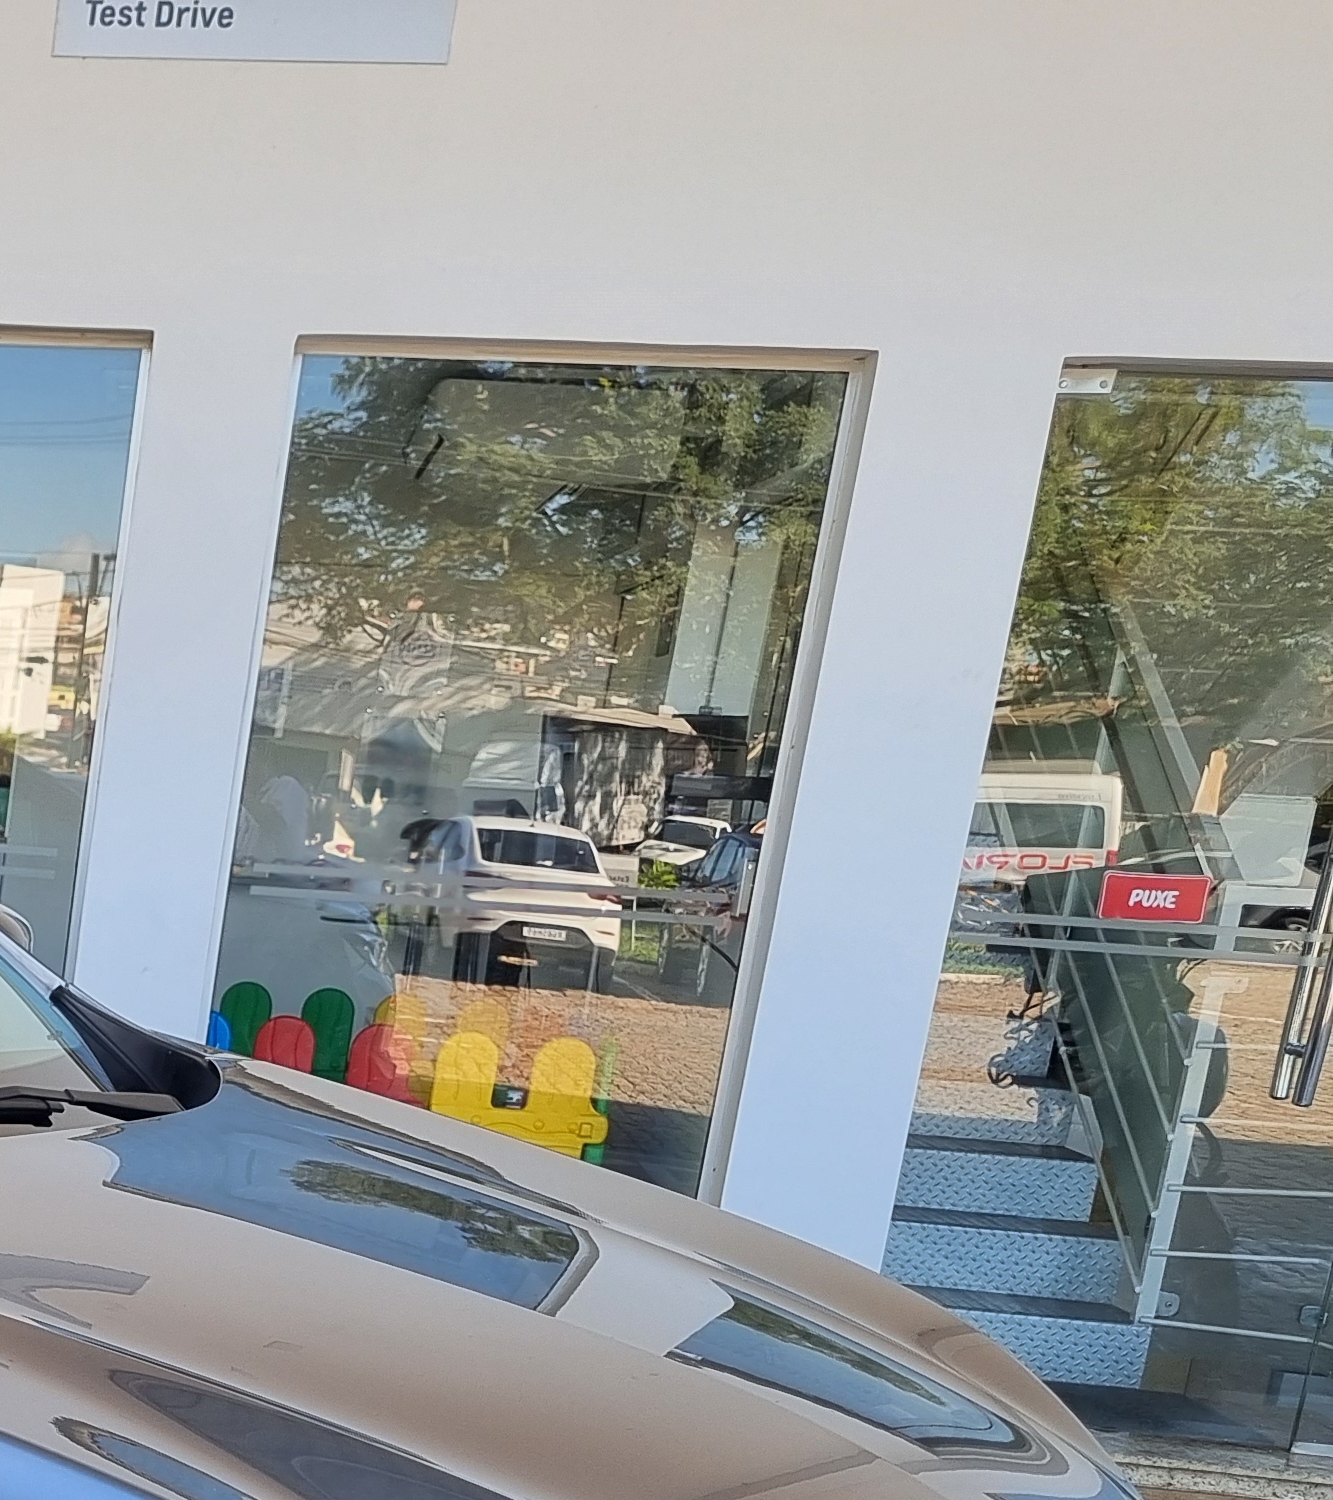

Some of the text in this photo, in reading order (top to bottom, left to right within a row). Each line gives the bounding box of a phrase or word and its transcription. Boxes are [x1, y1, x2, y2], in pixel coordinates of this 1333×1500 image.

[86, 0, 234, 28] Test Drive
[1128, 889, 1180, 909] PUXE
